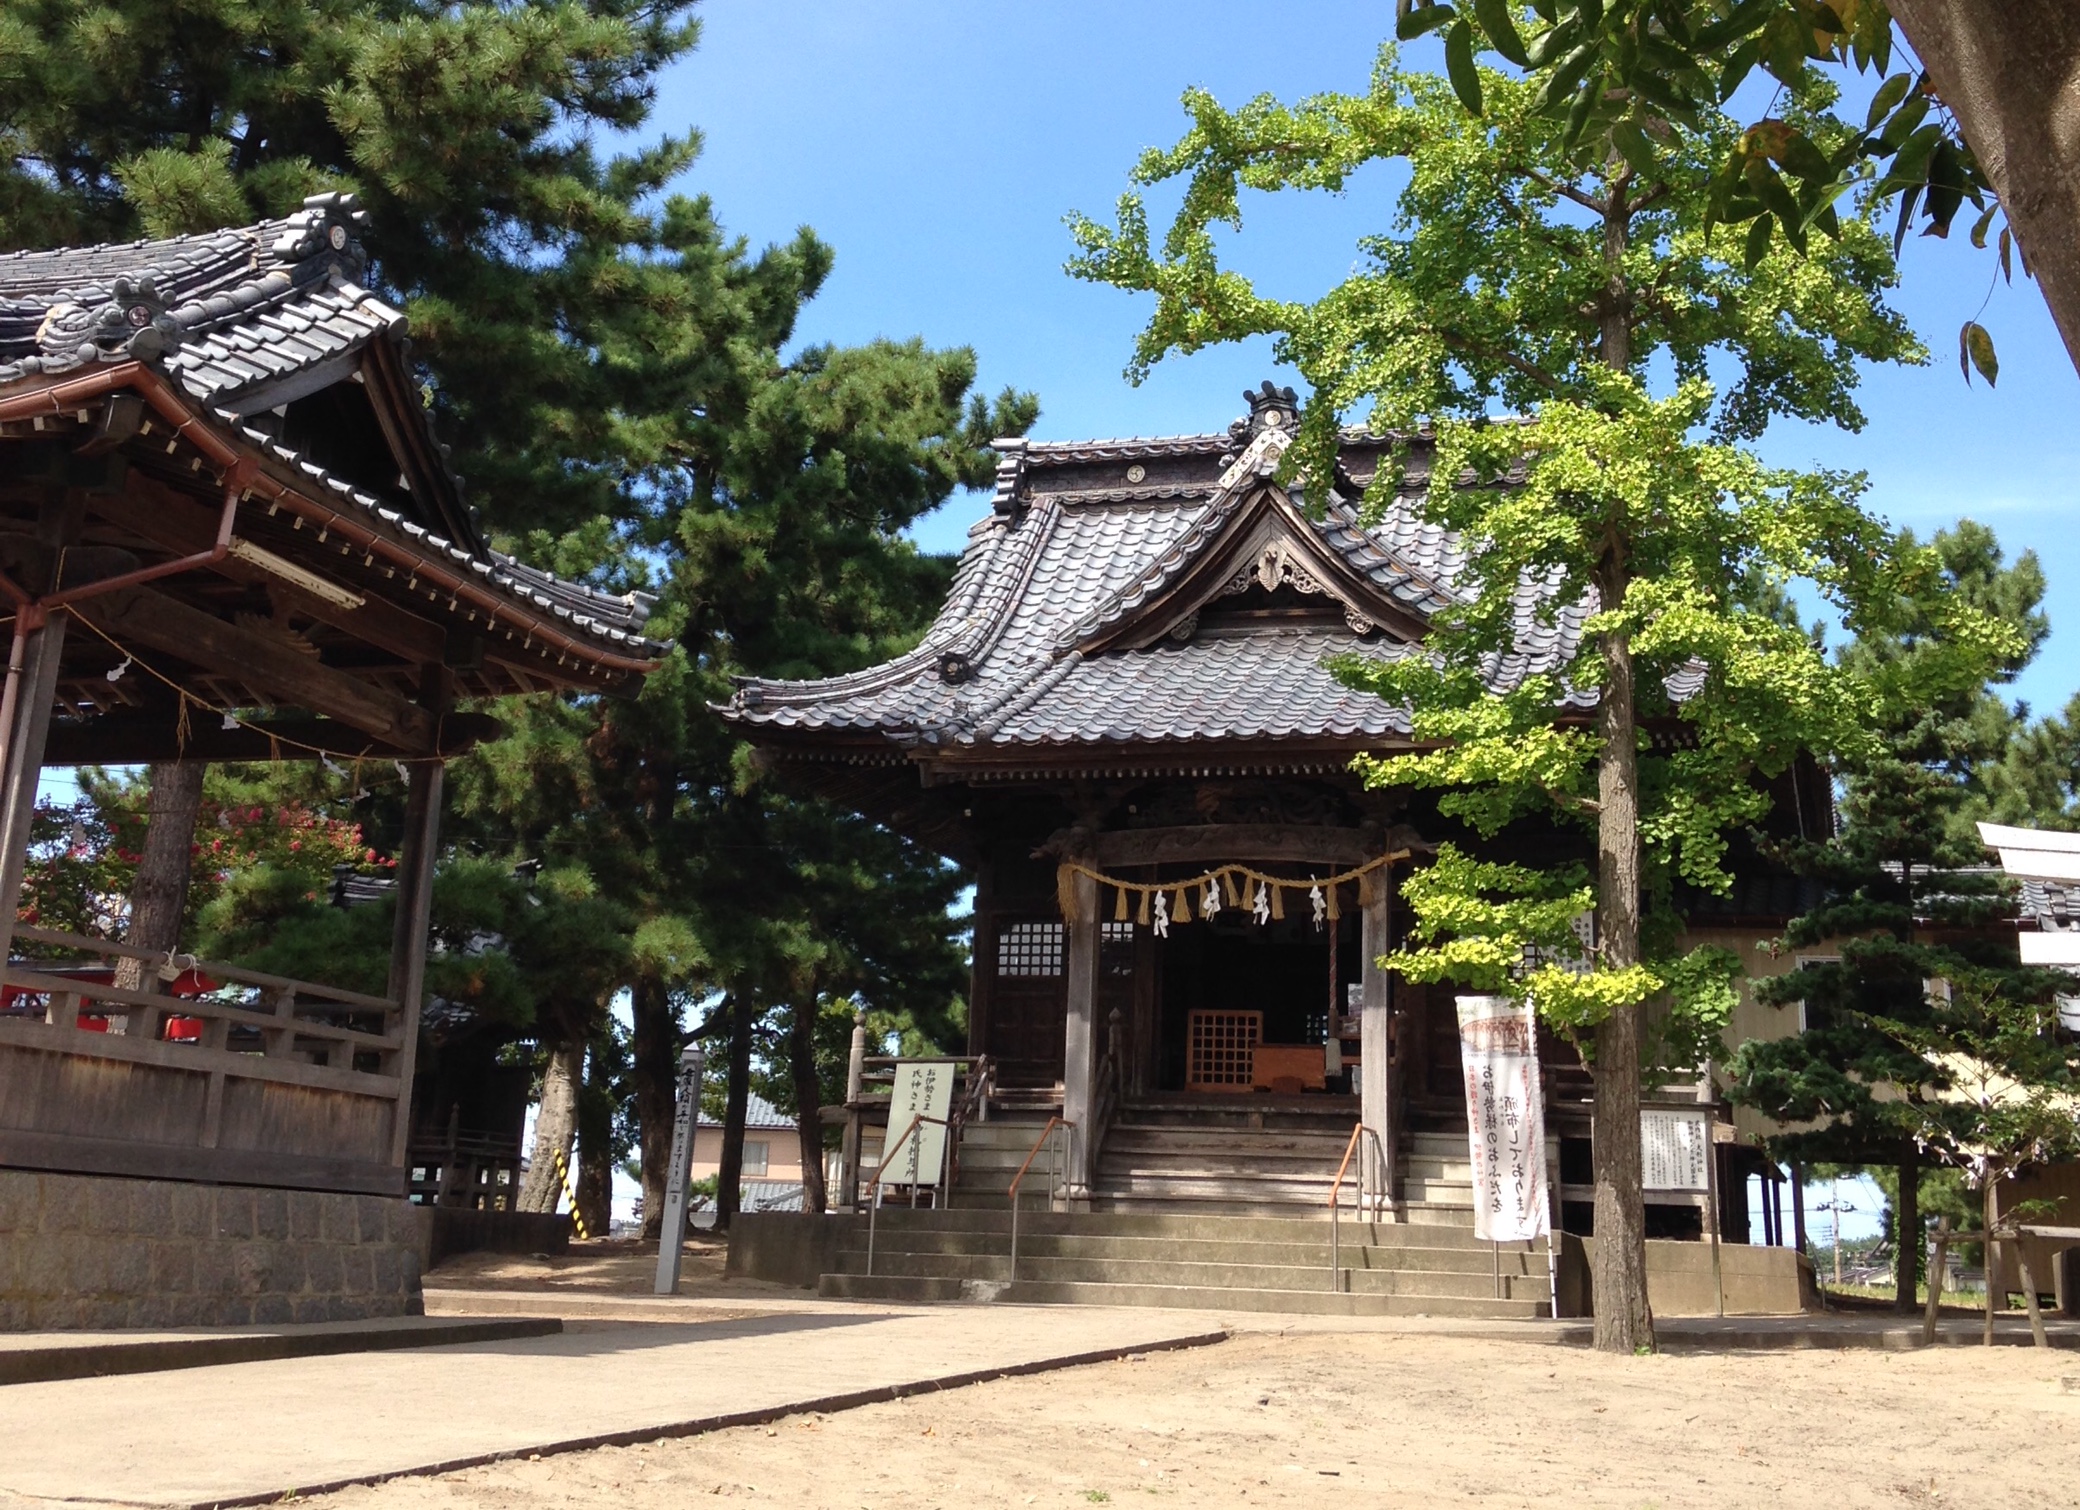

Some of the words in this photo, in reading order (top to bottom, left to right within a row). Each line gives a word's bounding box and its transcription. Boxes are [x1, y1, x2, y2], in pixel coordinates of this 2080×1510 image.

[908, 1068, 923, 1111] 氏神さま
[923, 1068, 937, 1111] お伊勢さま
